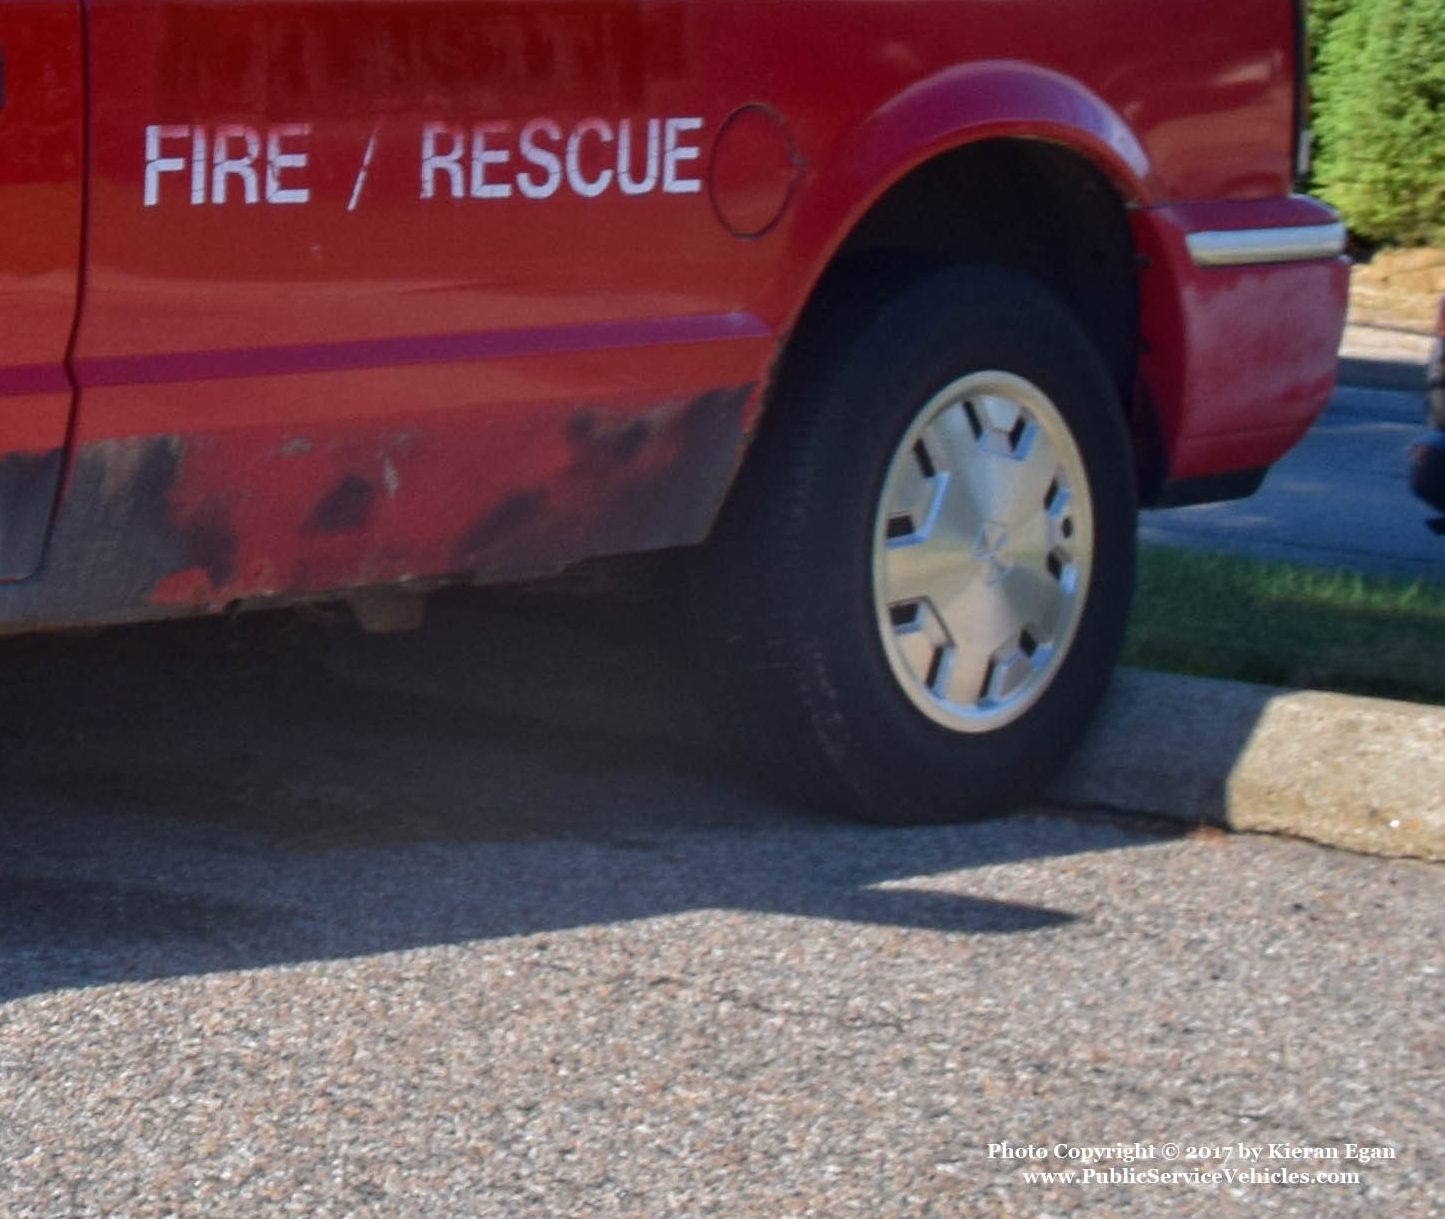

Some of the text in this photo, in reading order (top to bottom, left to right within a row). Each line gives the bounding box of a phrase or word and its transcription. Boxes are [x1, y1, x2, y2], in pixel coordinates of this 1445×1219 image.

[143, 117, 703, 211] FIRE / RESCUE
